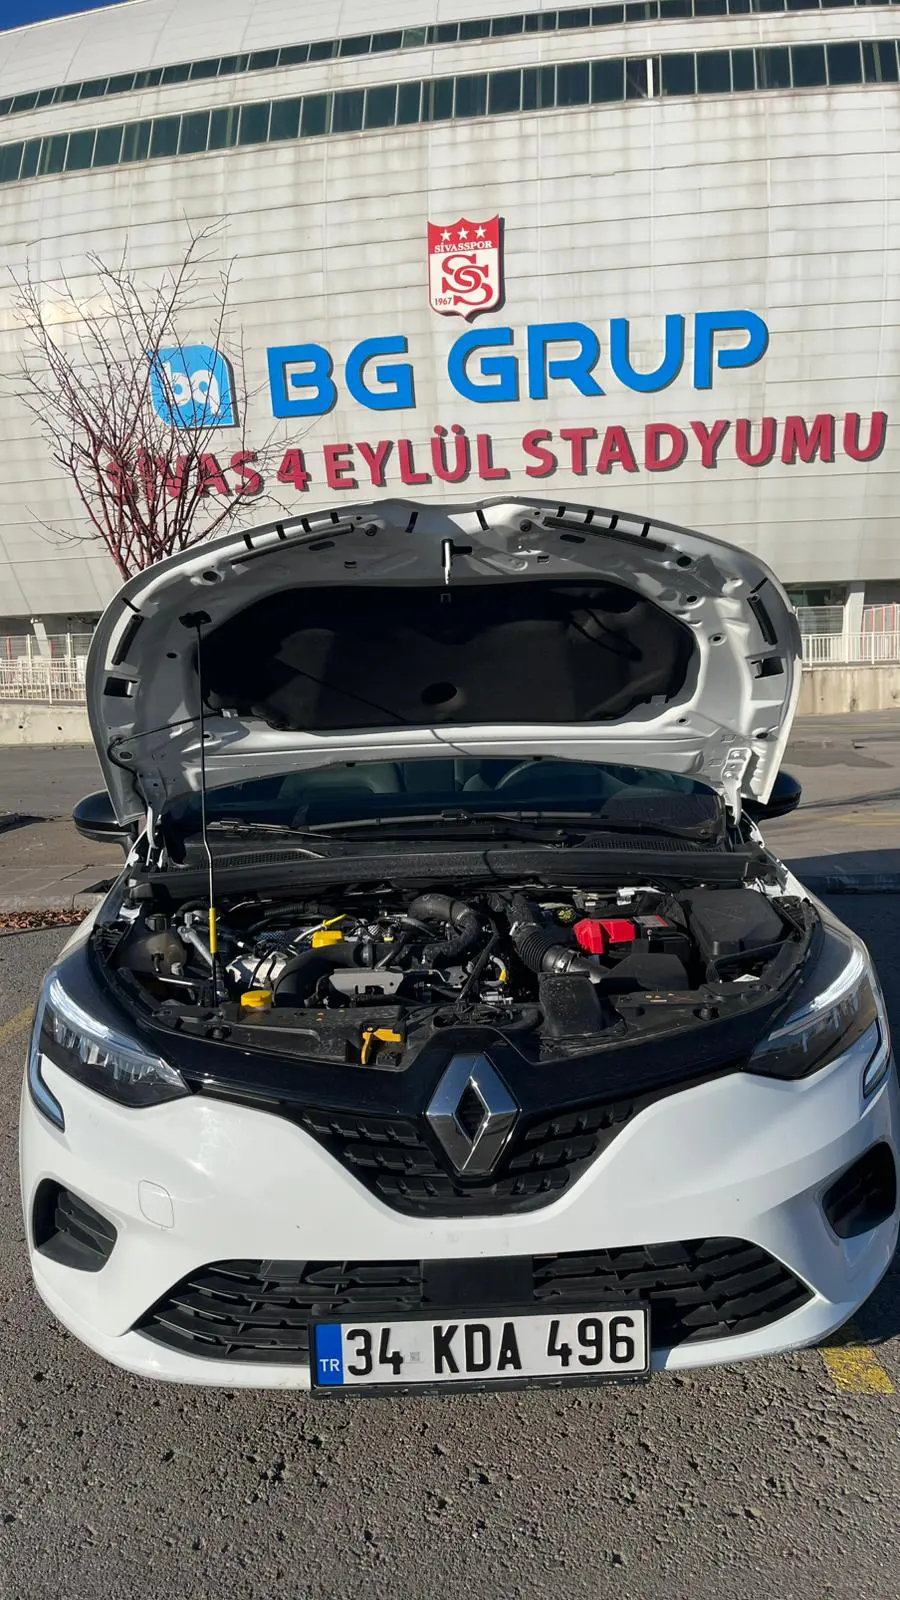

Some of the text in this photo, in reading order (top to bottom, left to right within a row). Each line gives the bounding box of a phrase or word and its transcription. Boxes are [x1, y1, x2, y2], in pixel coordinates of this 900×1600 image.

[434, 297, 453, 306] 1967
[266, 309, 769, 419] BG GRUP
[276, 447, 312, 492] 4
[322, 423, 511, 490] EYLÜL
[522, 411, 888, 479] STADYUMU
[319, 1315, 635, 1377] TR 34 KDA 496
